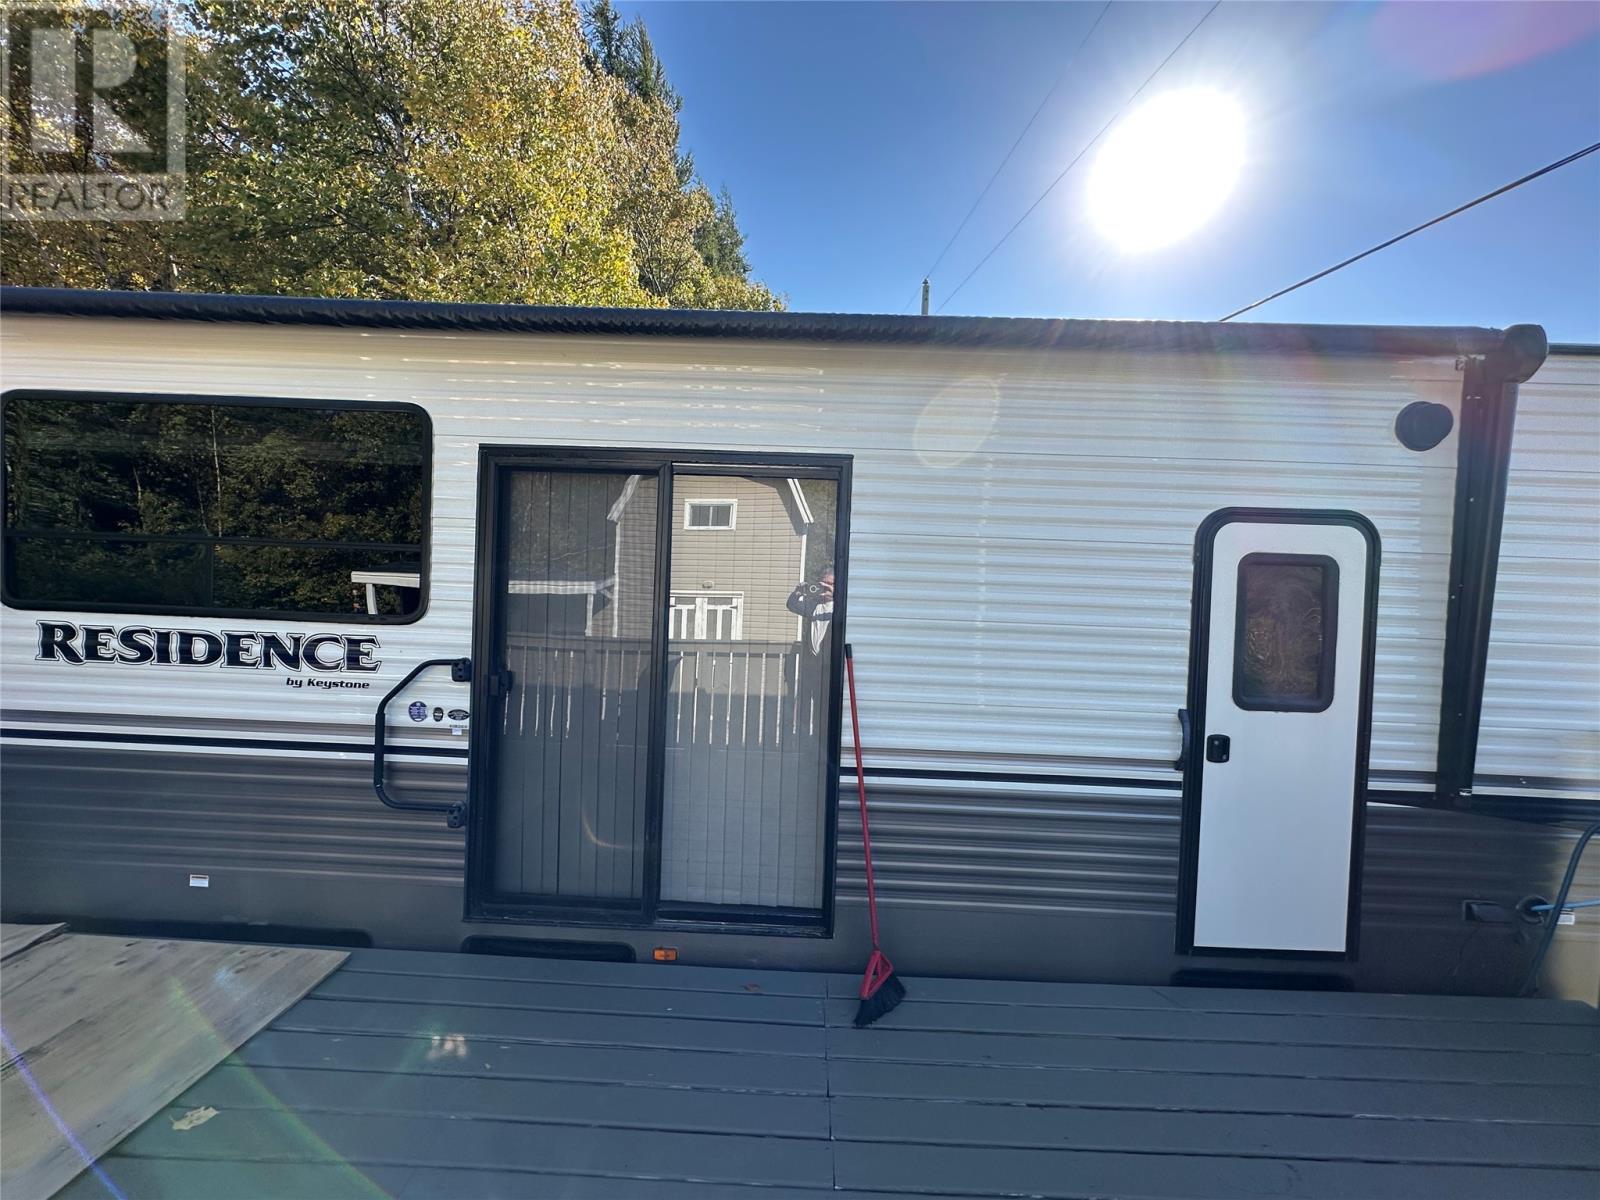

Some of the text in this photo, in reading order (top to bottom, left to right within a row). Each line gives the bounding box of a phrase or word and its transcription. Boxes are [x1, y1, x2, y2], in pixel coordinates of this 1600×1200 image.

[35, 620, 381, 673] RESIDENCE
[286, 677, 370, 690] by Keystone
